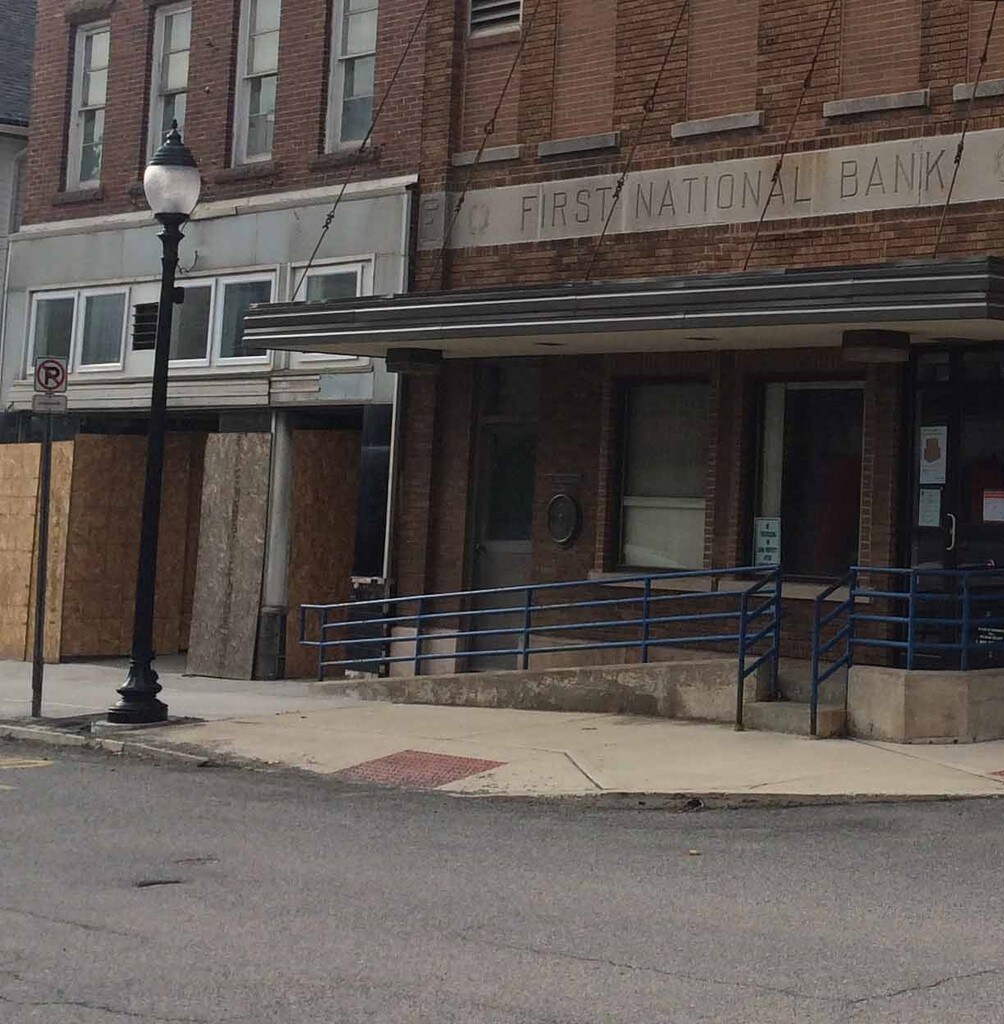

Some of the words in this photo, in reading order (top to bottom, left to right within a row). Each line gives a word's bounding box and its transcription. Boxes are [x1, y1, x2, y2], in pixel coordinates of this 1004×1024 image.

[521, 186, 613, 231] FIRST
[634, 166, 812, 220] NATIONAL
[840, 149, 946, 199] BANK
